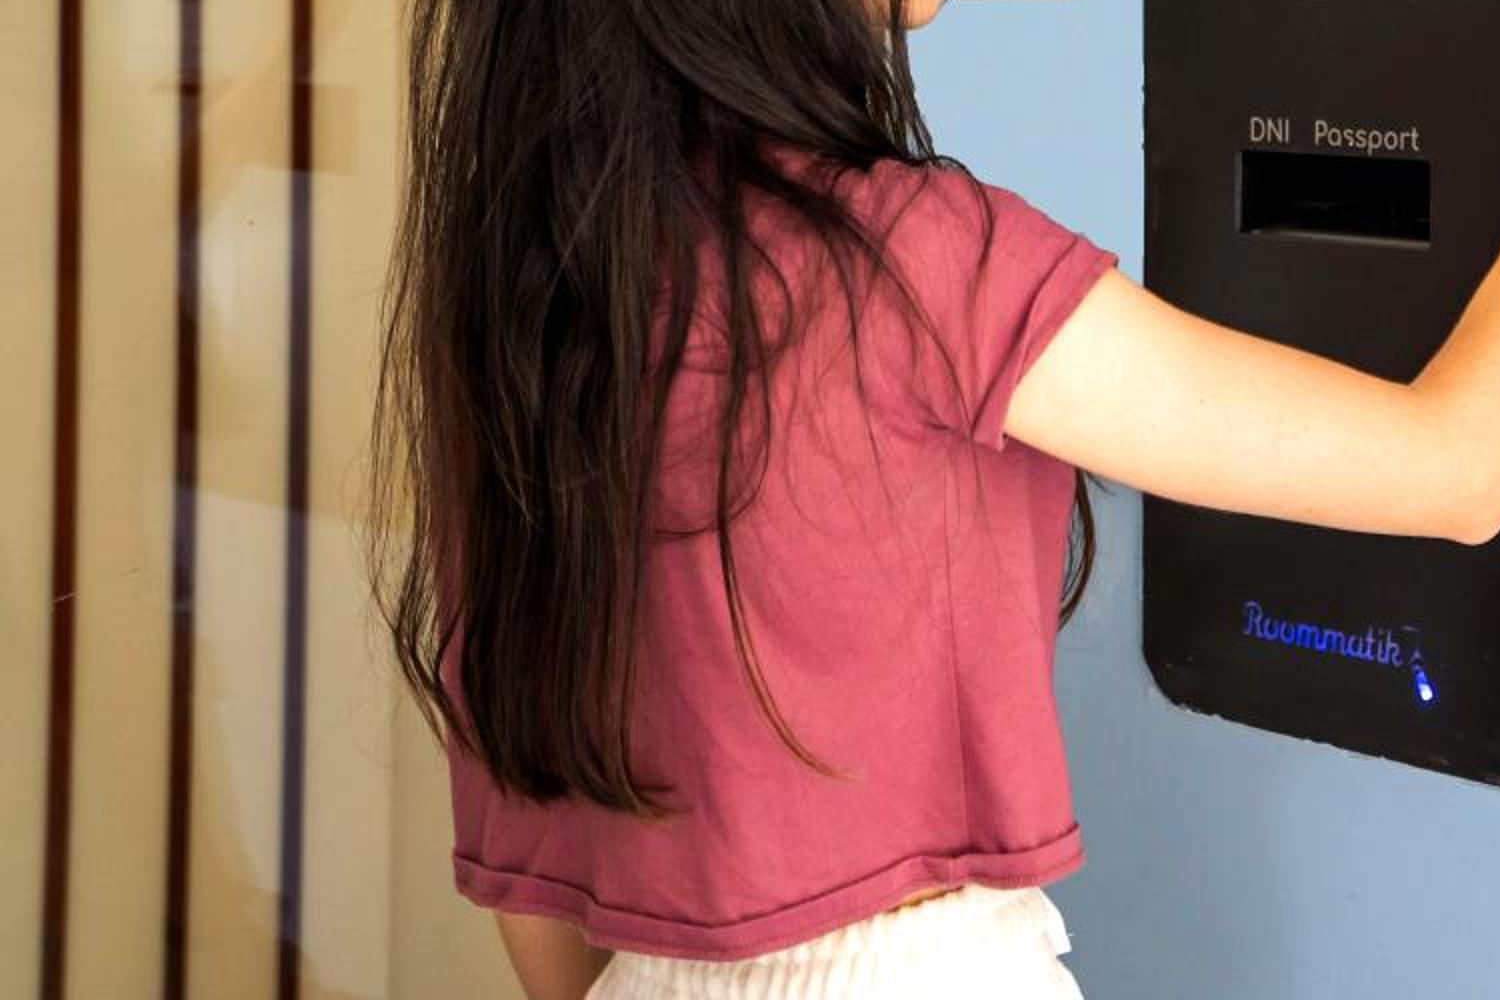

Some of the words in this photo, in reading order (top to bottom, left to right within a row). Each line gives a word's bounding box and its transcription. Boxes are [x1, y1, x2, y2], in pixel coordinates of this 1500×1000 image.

[1250, 116, 1290, 144] DNI
[1314, 119, 1420, 157] Passport
[1243, 600, 1403, 668] Roommatik
